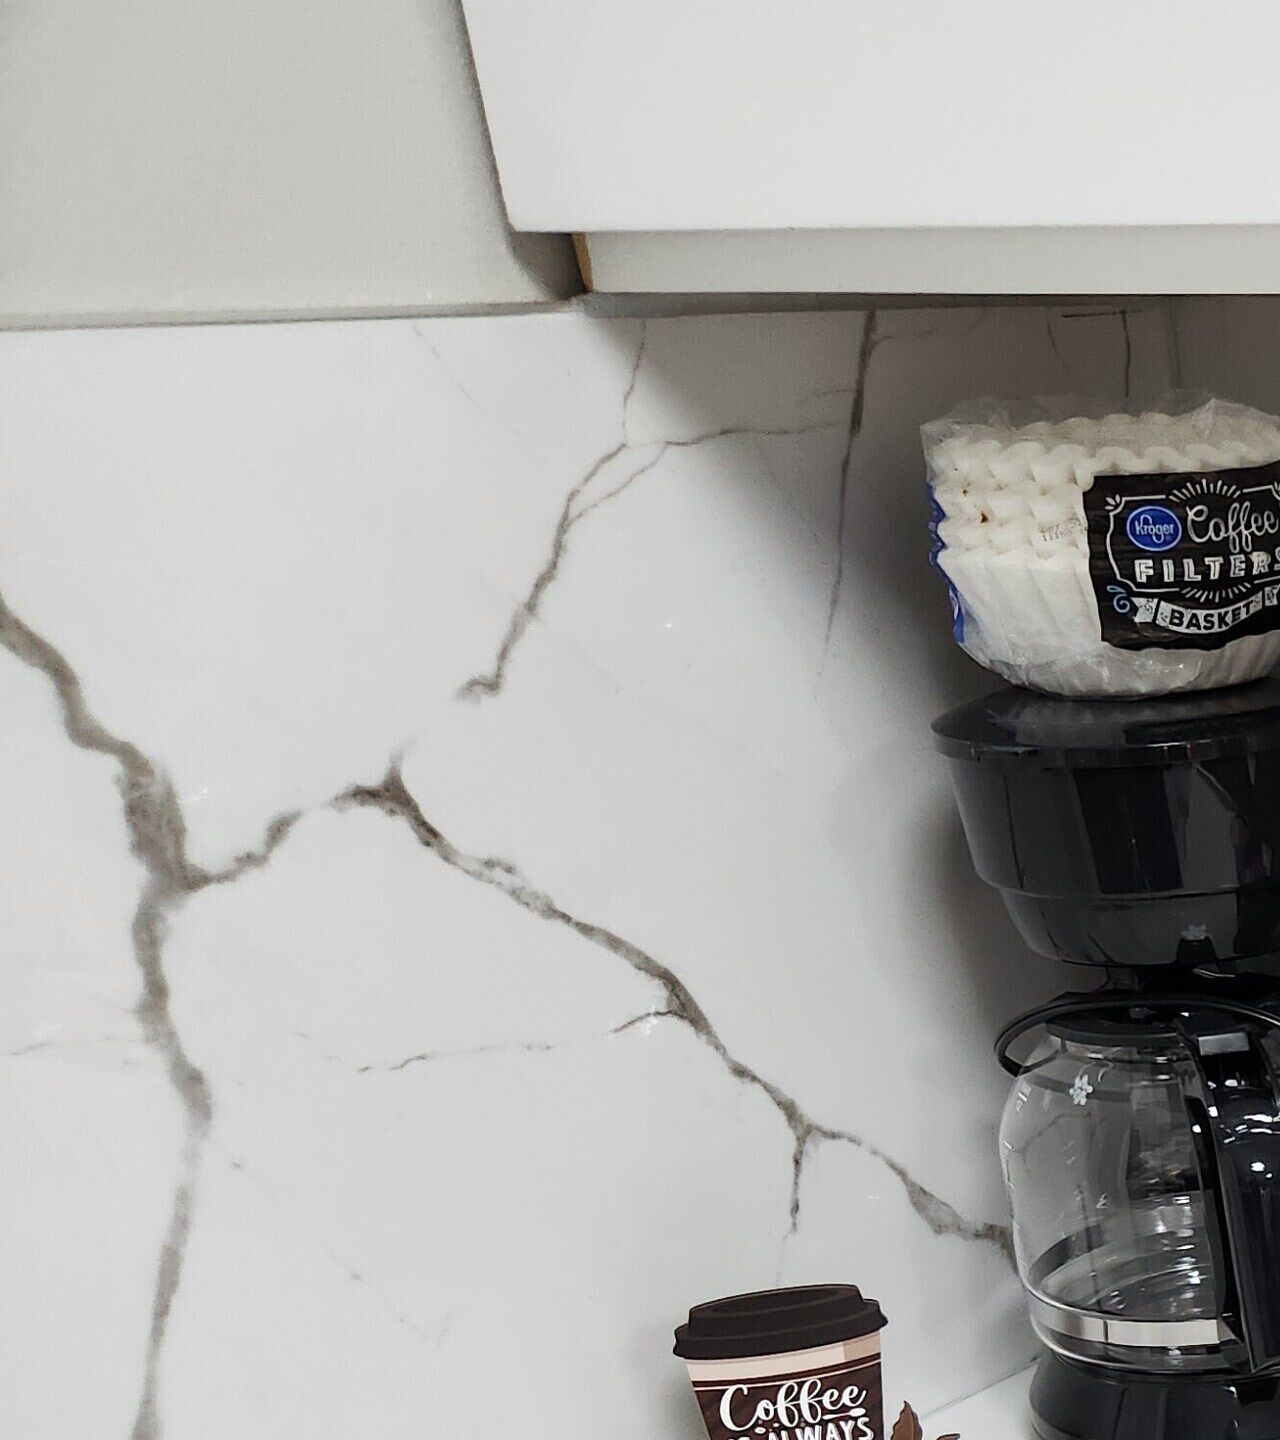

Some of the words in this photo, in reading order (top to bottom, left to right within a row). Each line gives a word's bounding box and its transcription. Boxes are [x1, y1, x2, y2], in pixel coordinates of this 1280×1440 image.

[1135, 514, 1174, 543] Kroger
[1186, 501, 1279, 553] Coffee
[1169, 604, 1251, 631] BASKET
[719, 1379, 867, 1432] Coffee
